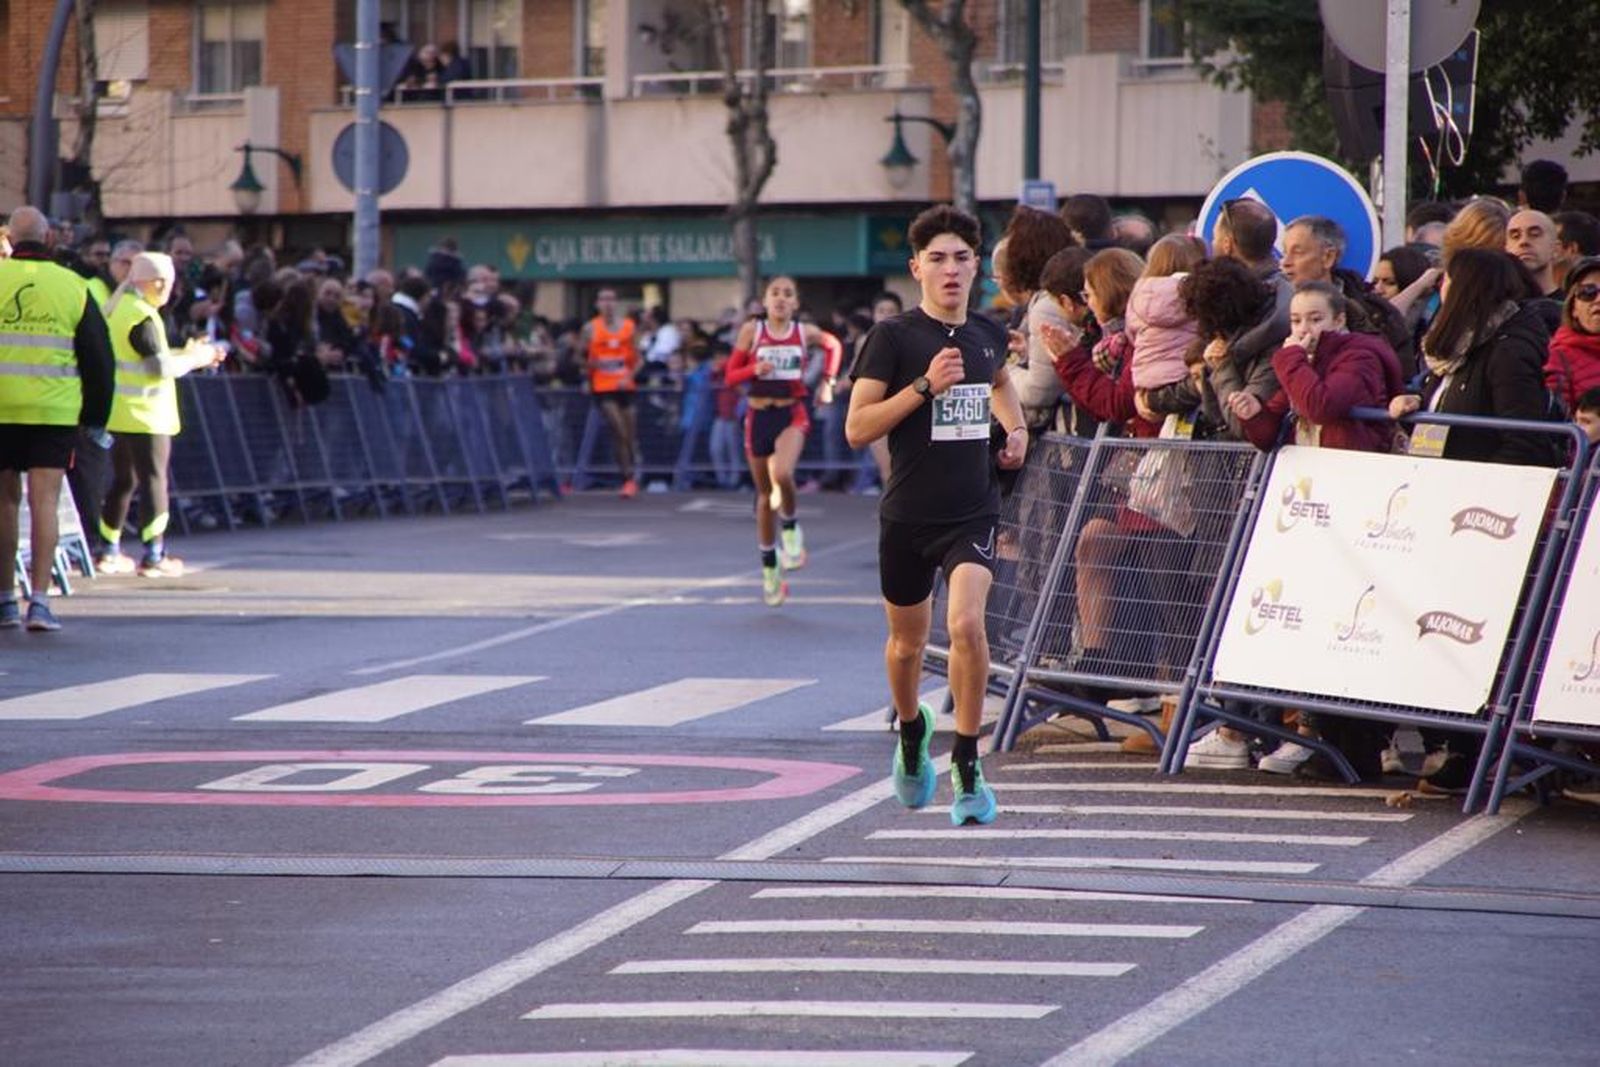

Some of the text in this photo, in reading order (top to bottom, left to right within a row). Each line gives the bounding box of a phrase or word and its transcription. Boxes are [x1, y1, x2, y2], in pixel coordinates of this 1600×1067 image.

[535, 232, 777, 270] CAJA RURAL DE SALAMAA
[942, 398, 983, 422] 5460
[1289, 501, 1331, 519] SETEL
[1258, 603, 1303, 623] SETEL
[195, 762, 642, 795] 30
